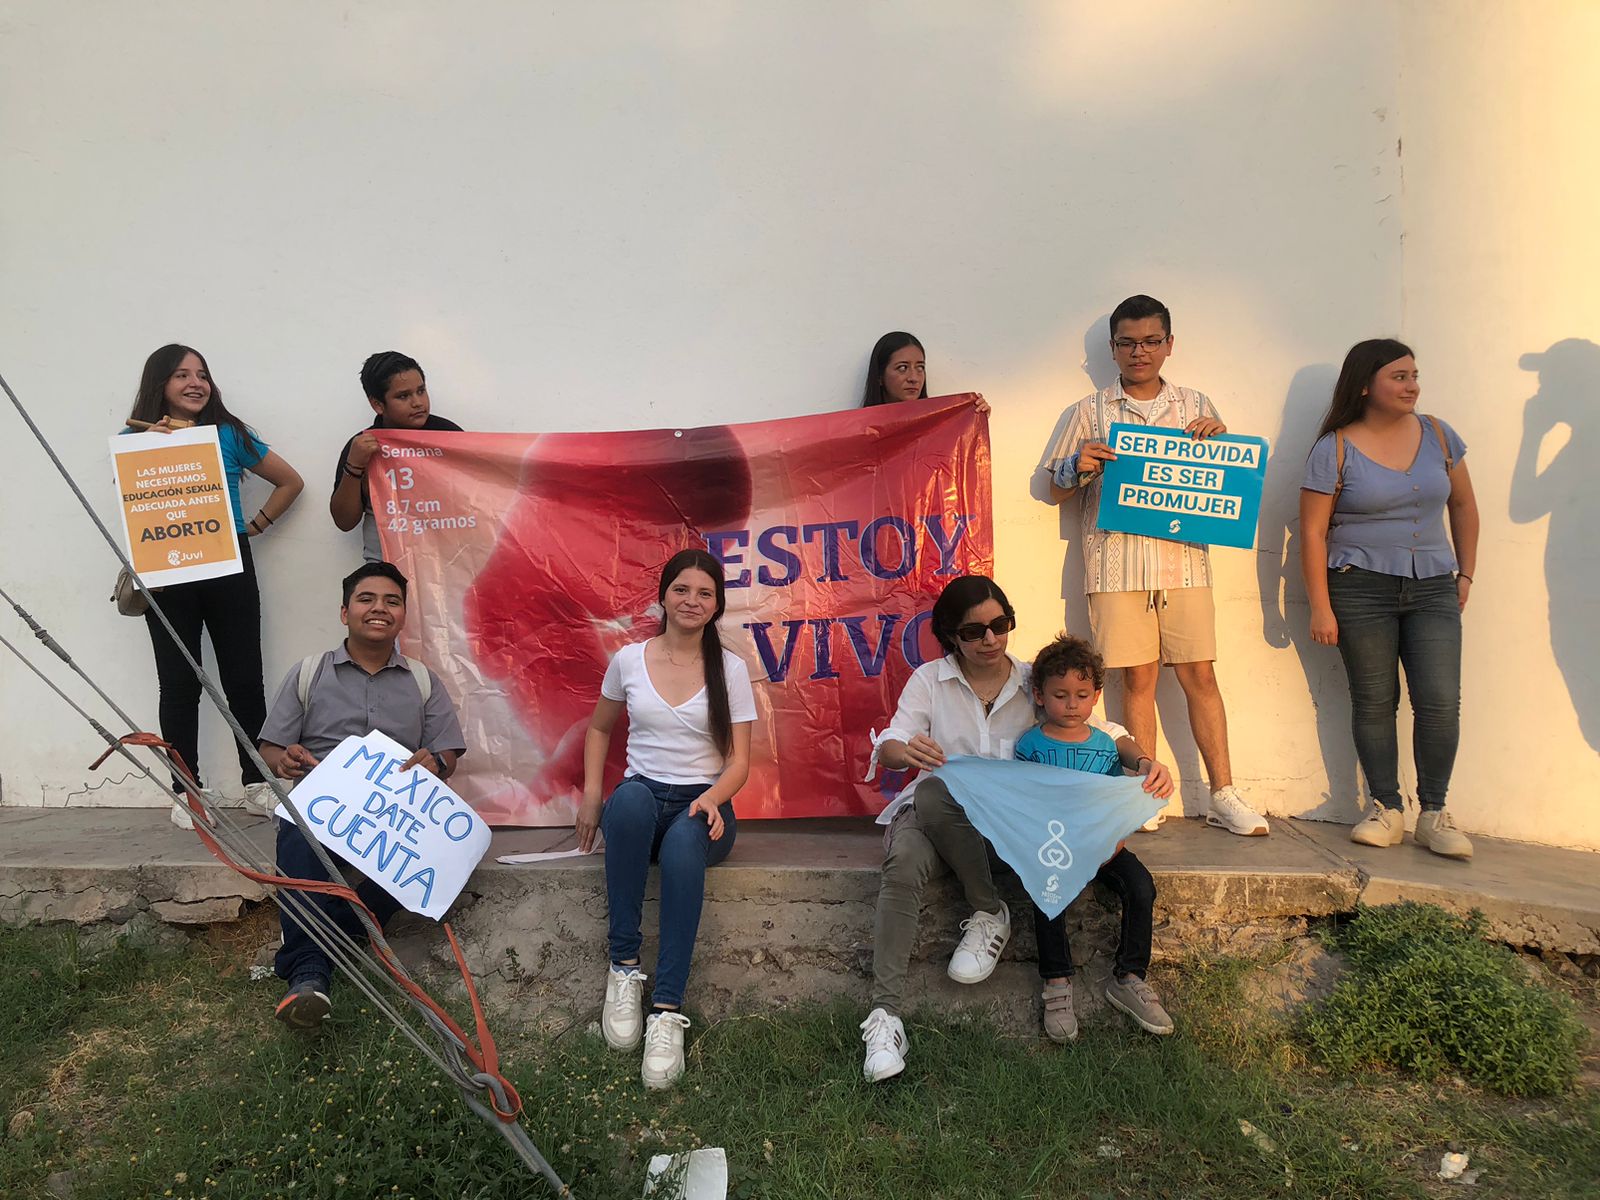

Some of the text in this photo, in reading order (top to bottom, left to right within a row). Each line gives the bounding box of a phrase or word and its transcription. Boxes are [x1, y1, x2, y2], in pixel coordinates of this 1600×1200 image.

[381, 445, 444, 458] Semana
[1119, 435, 1255, 464] SER PROVIDA
[137, 462, 203, 478] LAS MUJERES
[385, 467, 415, 490] 13
[1148, 465, 1218, 488] ES SER
[136, 473, 207, 489] NECESITAMOS
[123, 483, 224, 502] EDUCACIÓN SEXUAL
[1123, 488, 1236, 516] PROMUJER
[130, 495, 220, 513] ADECUADA ANTES
[386, 499, 441, 515] 8.7 cm
[166, 510, 188, 522] QUE
[388, 516, 476, 535] 42 gramos
[140, 519, 221, 543] ABORTO
[701, 514, 977, 589] ESTOY
[362, 791, 426, 845] DATE
[307, 795, 436, 909] CUENTA
